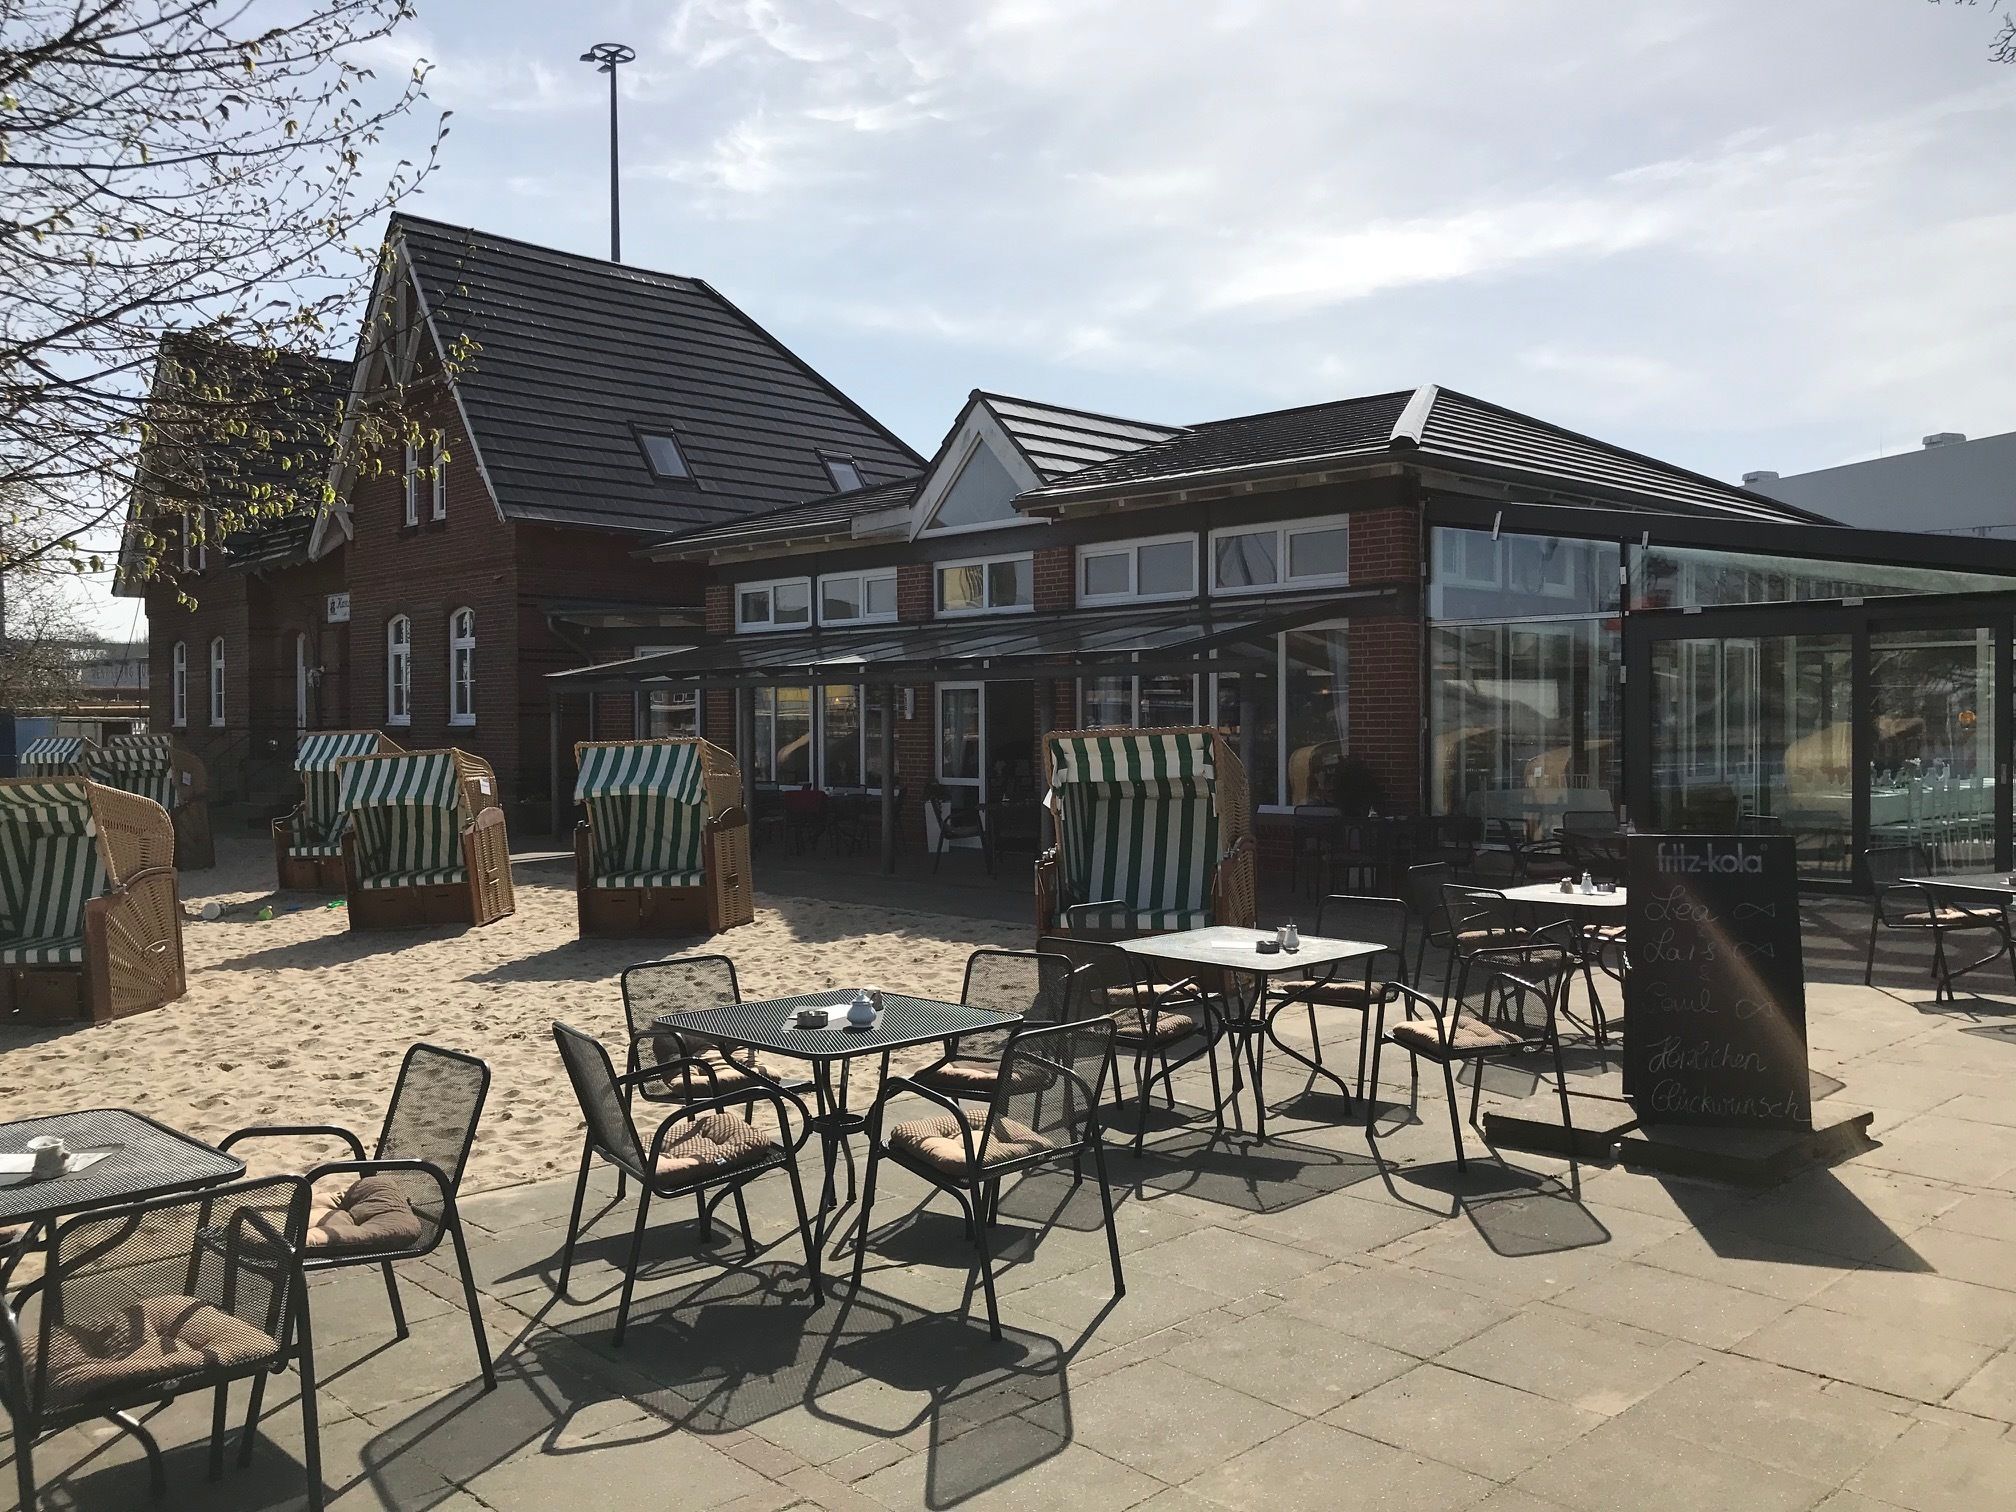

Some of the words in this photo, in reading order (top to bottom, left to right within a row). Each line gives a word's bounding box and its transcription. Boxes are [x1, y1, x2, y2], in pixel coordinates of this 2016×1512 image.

[1656, 841, 1763, 873] fritz-kola
[1645, 885, 1720, 921] Lea
[1643, 927, 1714, 963] Lars
